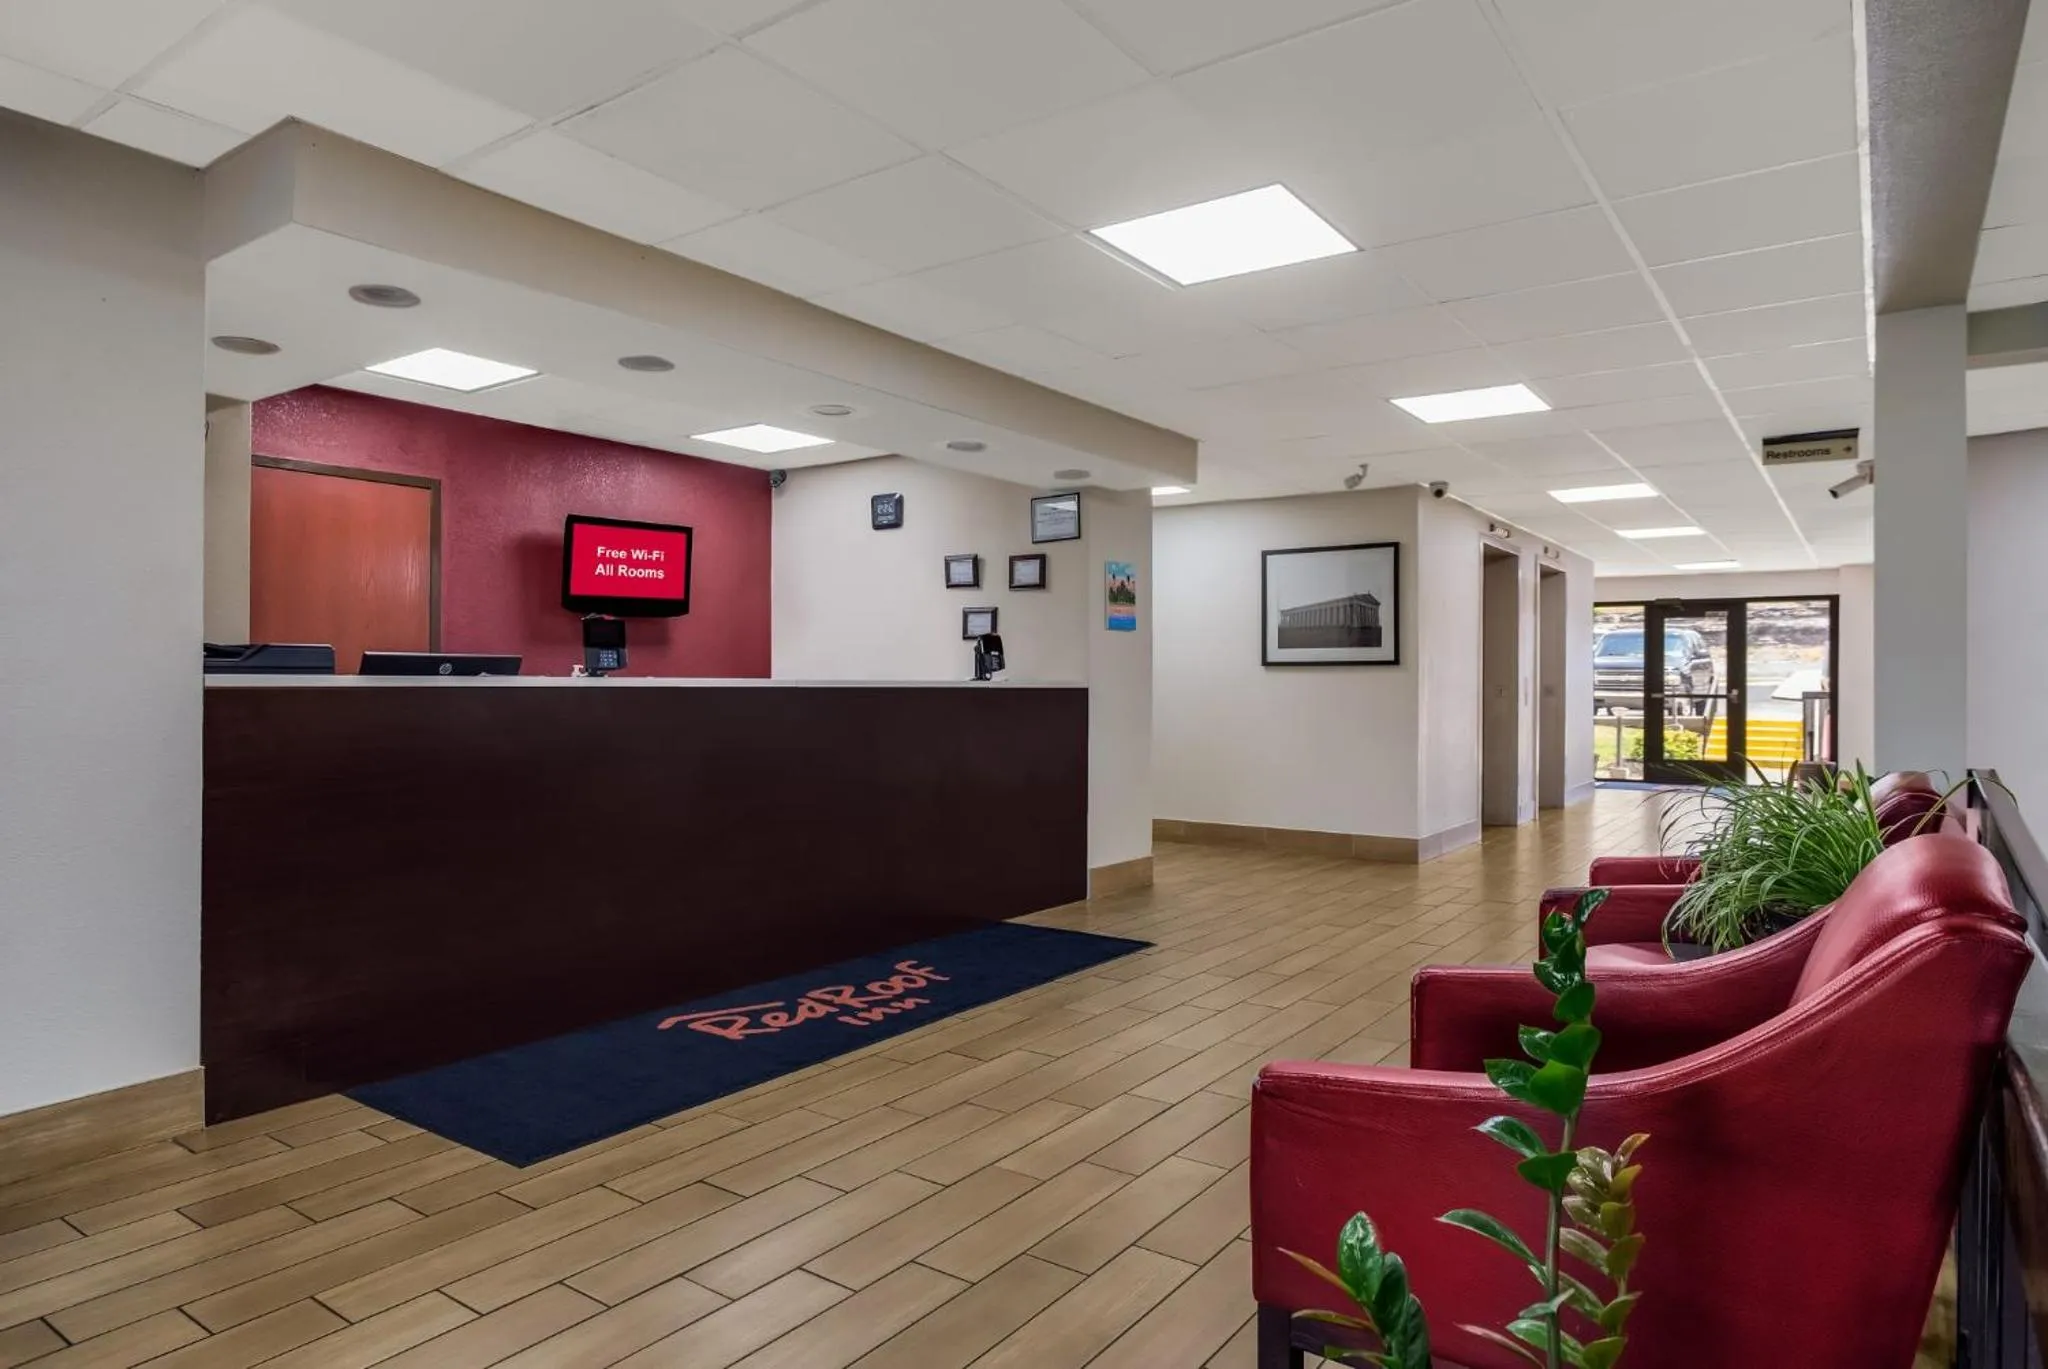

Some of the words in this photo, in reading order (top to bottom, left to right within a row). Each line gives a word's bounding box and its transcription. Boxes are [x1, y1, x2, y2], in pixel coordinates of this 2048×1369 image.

[1766, 447, 1831, 460] Restrooms
[596, 546, 628, 559] Free
[631, 549, 665, 562] Wi-Fi
[594, 563, 614, 577] All
[618, 564, 665, 580] Rooms
